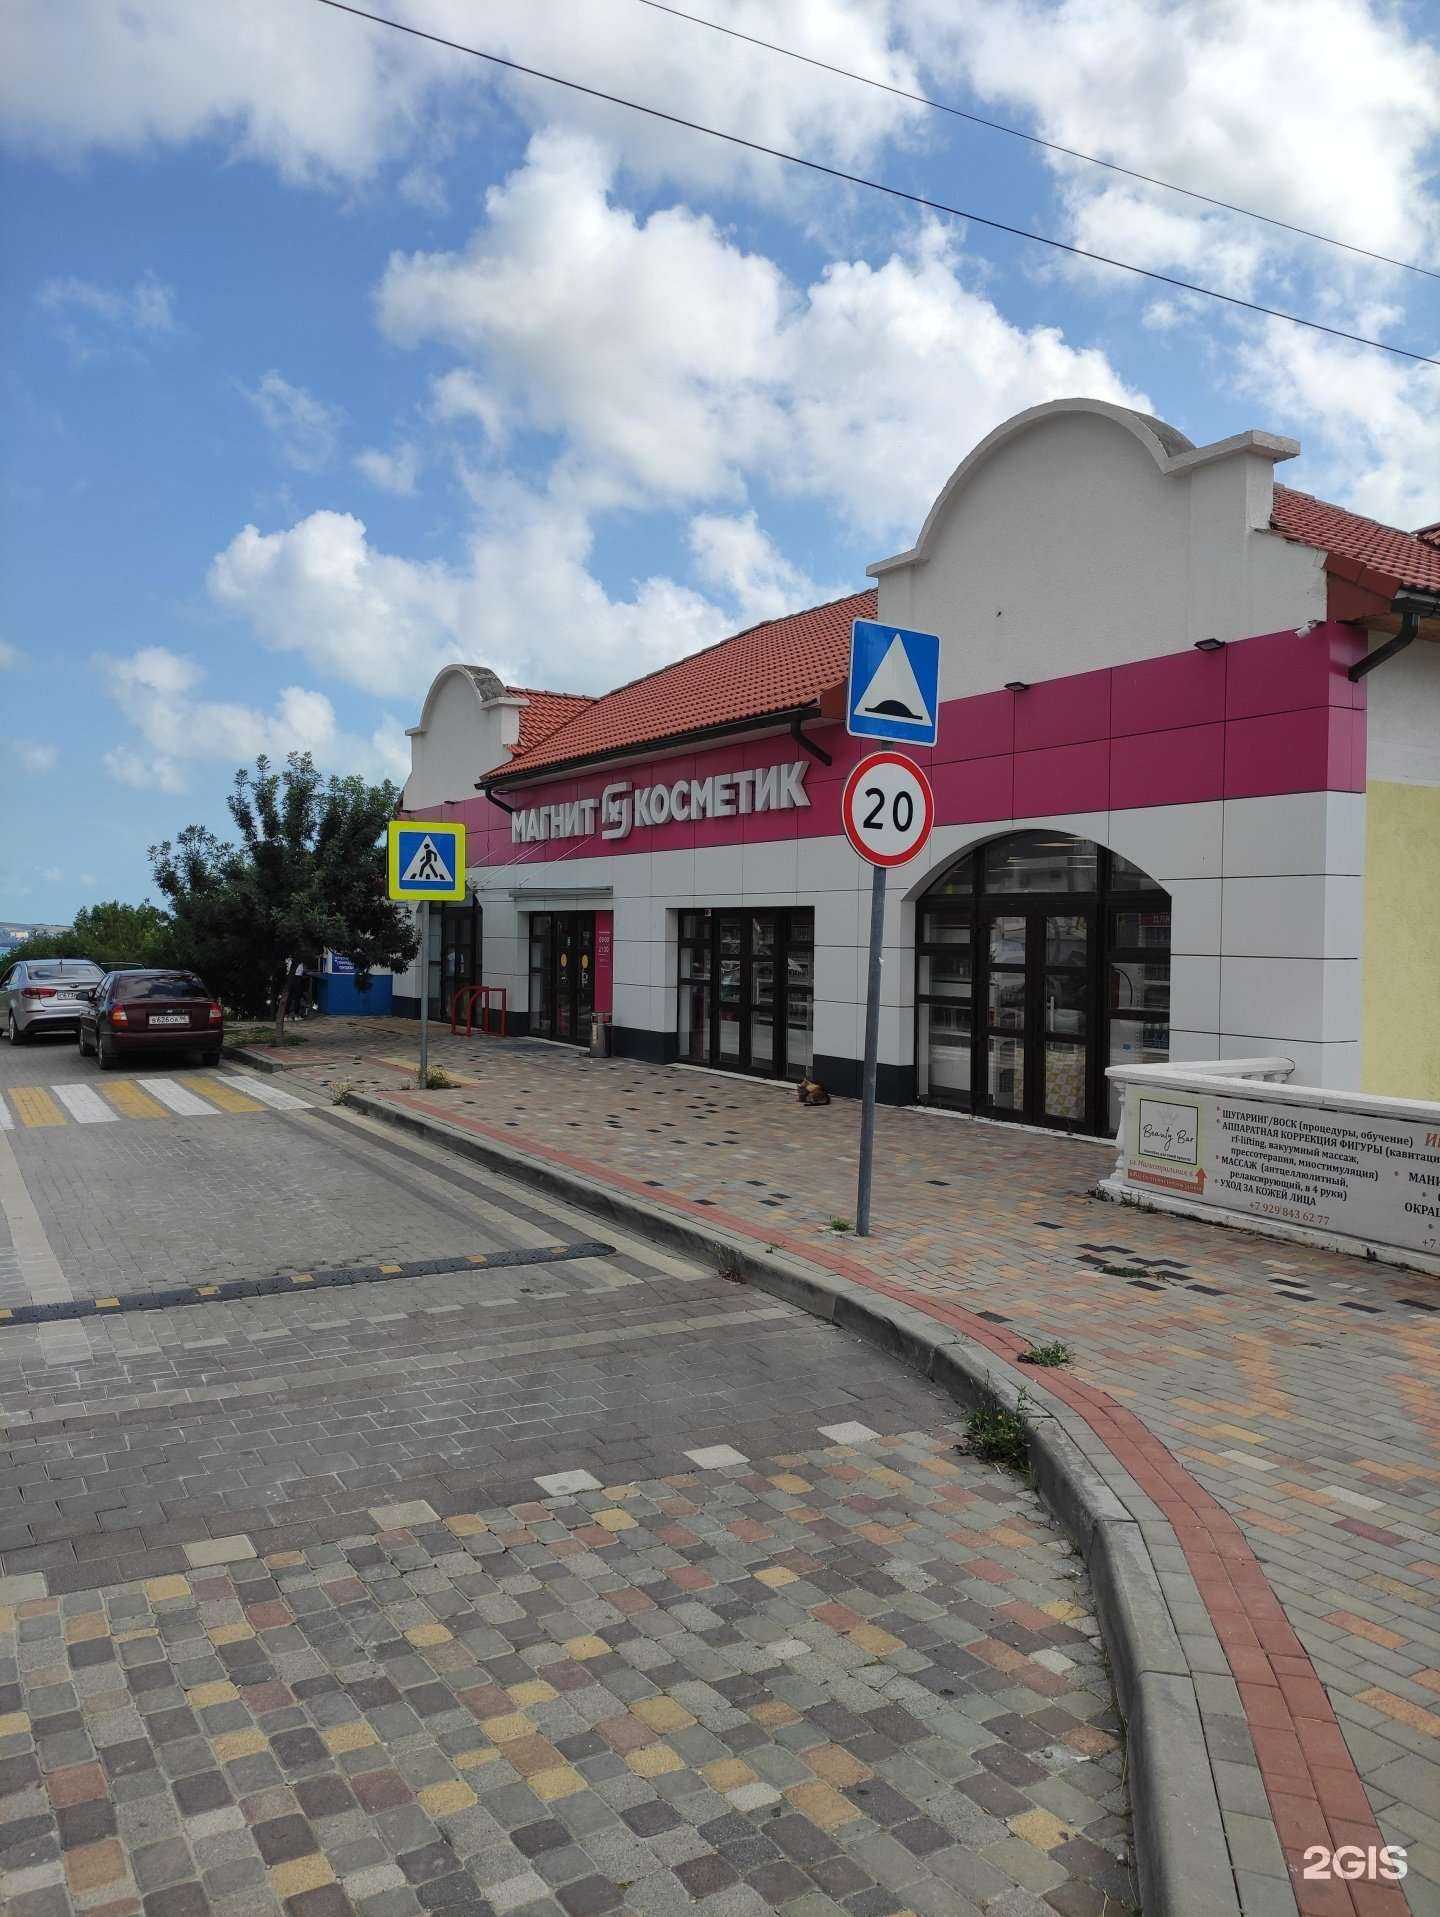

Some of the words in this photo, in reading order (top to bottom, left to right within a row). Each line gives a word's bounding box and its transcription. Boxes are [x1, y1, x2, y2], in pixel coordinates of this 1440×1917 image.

[511, 798, 598, 843] МАГНИТ
[634, 760, 811, 827] КОСМЕТИК
[863, 787, 914, 832] 20
[1143, 1124, 1173, 1151] Beauty
[1176, 1129, 1195, 1144] Bar
[1222, 1109, 1297, 1129] ШУГАРИНГ/ВОСК
[1299, 1120, 1359, 1139] (процедуры,
[1361, 1131, 1413, 1148] обучение)
[1222, 1121, 1279, 1138] АППАРАТНАЯ
[1280, 1130, 1337, 1148] КОРРЕКЦИЯ
[1340, 1139, 1382, 1155] ФИГУРЫ
[1221, 1156, 1257, 1170] МАССАЖ
[1231, 1147, 1296, 1166] прессотерапия,
[1298, 1159, 1379, 1181] миостимуляция)
[1268, 1142, 1320, 1157] вакуумный
[1322, 1150, 1359, 1165] массаж,
[1220, 1179, 1242, 1192] УХОД
[1243, 1183, 1254, 1193] ЗА
[1256, 1185, 1288, 1200] КОЖЕЙ
[1289, 1193, 1317, 1206] ЛИЦА
[1230, 1170, 1303, 1192] релаксирующий,
[1312, 1185, 1318, 1194] 4
[1320, 1188, 1347, 1201] руки)
[1249, 1201, 1260, 1210] +7
[1262, 1203, 1280, 1214] 929
[1282, 1207, 1300, 1219] 843
[1302, 1212, 1314, 1221] 62
[1316, 1215, 1330, 1225] 77
[1422, 1238, 1436, 1248] +7
